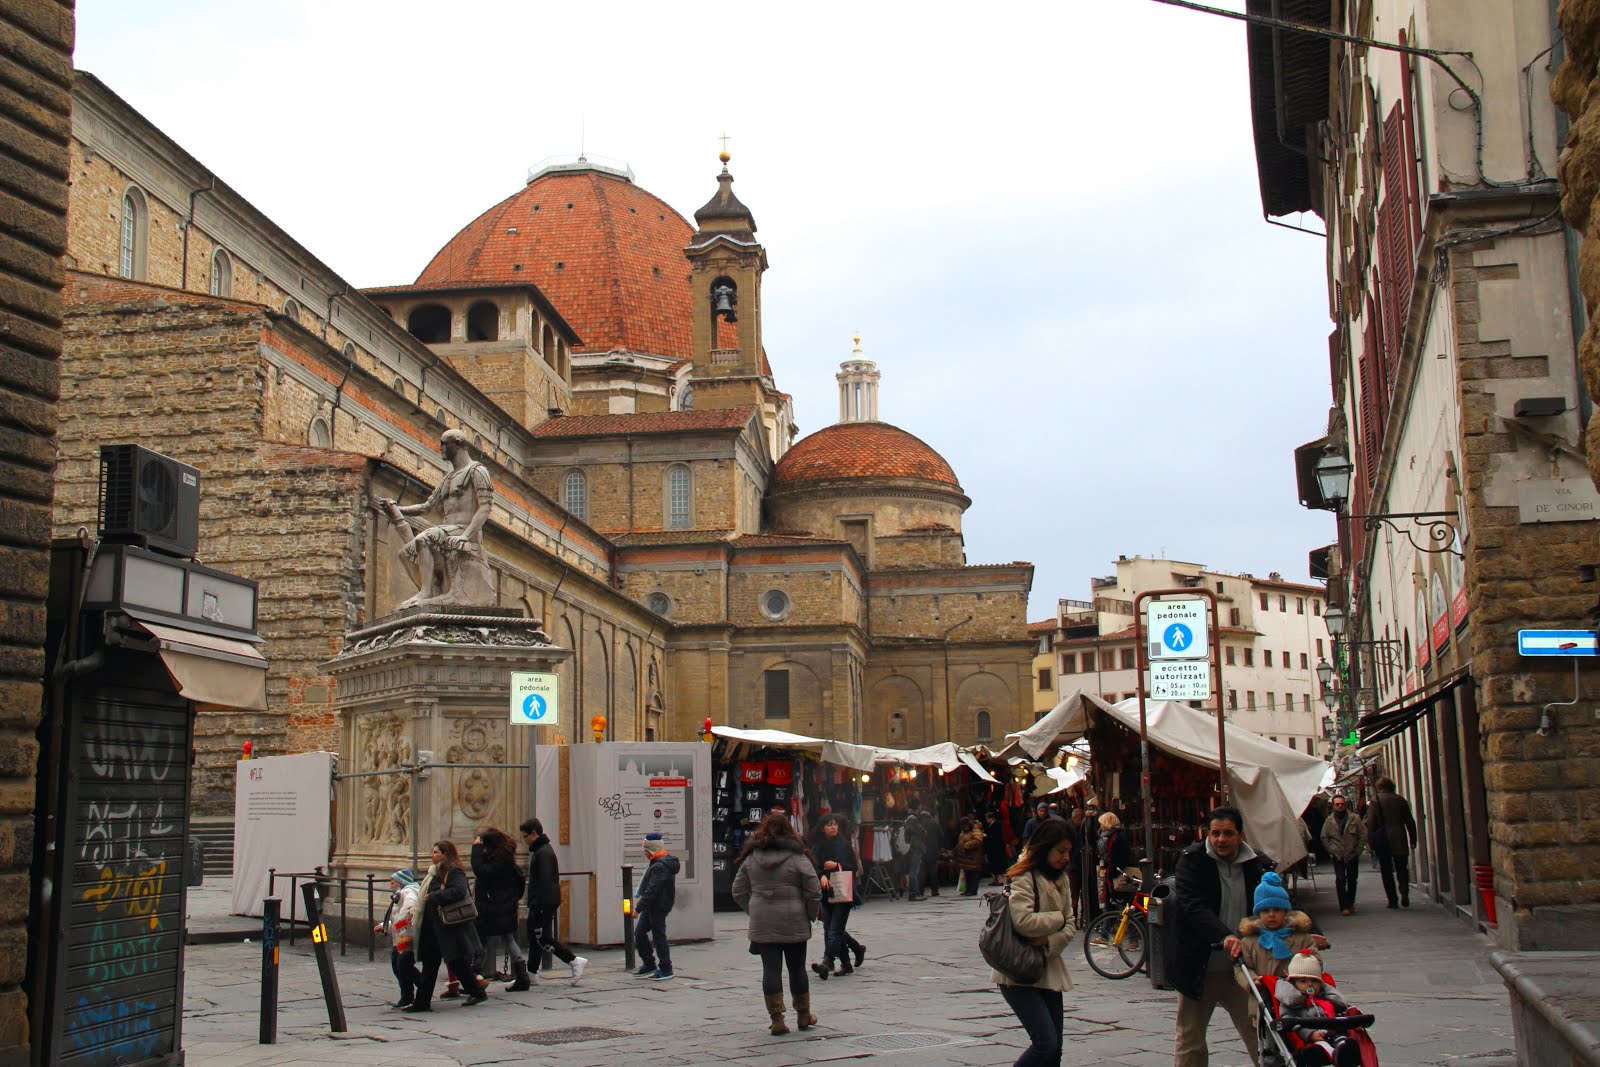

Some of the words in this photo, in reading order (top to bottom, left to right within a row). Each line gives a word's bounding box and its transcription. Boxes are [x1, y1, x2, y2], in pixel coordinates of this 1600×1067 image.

[1556, 502, 1593, 512] GINORI
[1157, 611, 1198, 620] pedonale
[1154, 672, 1206, 680] autorizzati
